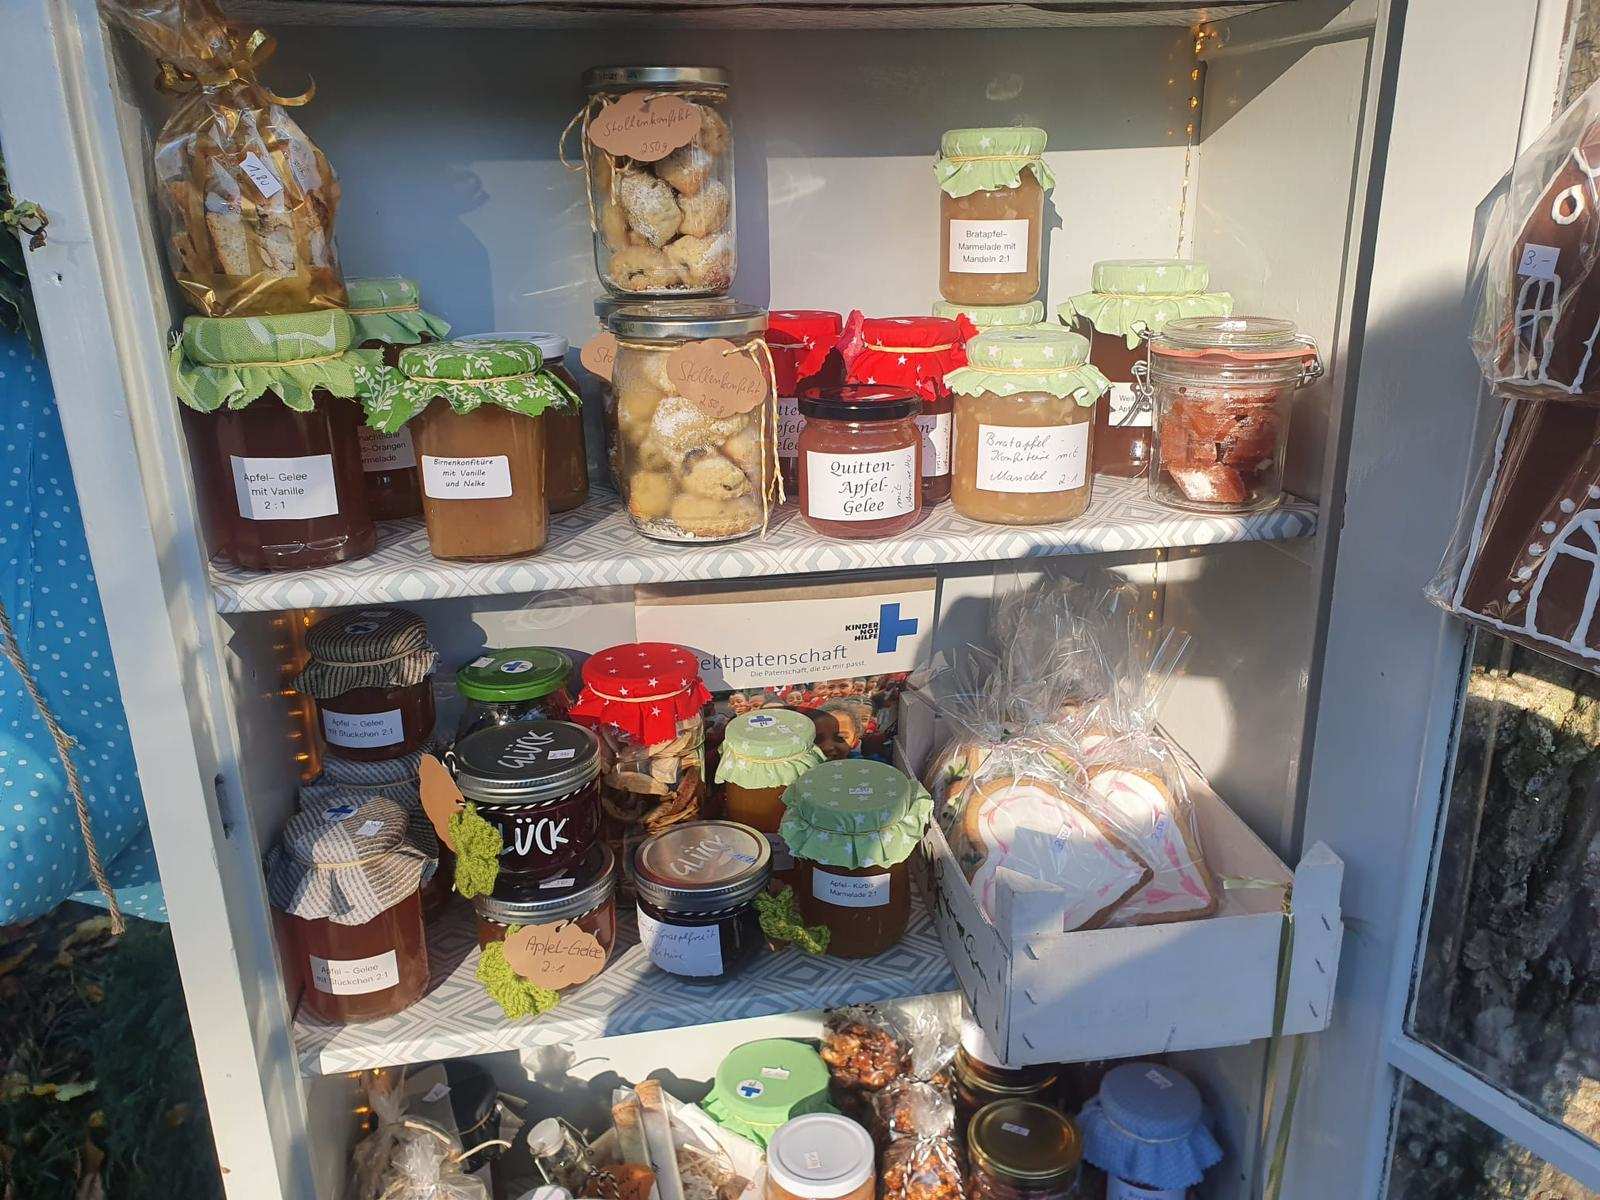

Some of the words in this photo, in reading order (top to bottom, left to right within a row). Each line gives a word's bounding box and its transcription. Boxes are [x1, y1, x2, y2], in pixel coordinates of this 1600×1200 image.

[966, 230, 1008, 239] Bratapfel-
[958, 243, 1002, 251] Marmelade
[1003, 242, 1016, 250] mit
[962, 255, 997, 263] Mandeln
[998, 254, 1010, 263] 2:1
[433, 458, 494, 466] Birnenkonfitüre
[460, 469, 487, 477] Vanille
[830, 461, 895, 476] Quitten-
[242, 472, 275, 482] Apfel-
[278, 472, 308, 482] Gelee
[445, 480, 460, 488] und
[838, 476, 889, 497] Apfel-
[251, 487, 268, 496] mit
[271, 486, 305, 496] Vanille
[843, 499, 885, 516] Gelee
[845, 622, 879, 632] KINDER
[860, 628, 879, 636] NOT
[854, 633, 878, 641] HILFE
[700, 644, 848, 673] ektpatenschaft
[750, 670, 763, 678] Die
[810, 665, 821, 673] die
[352, 964, 379, 974] Gelee
